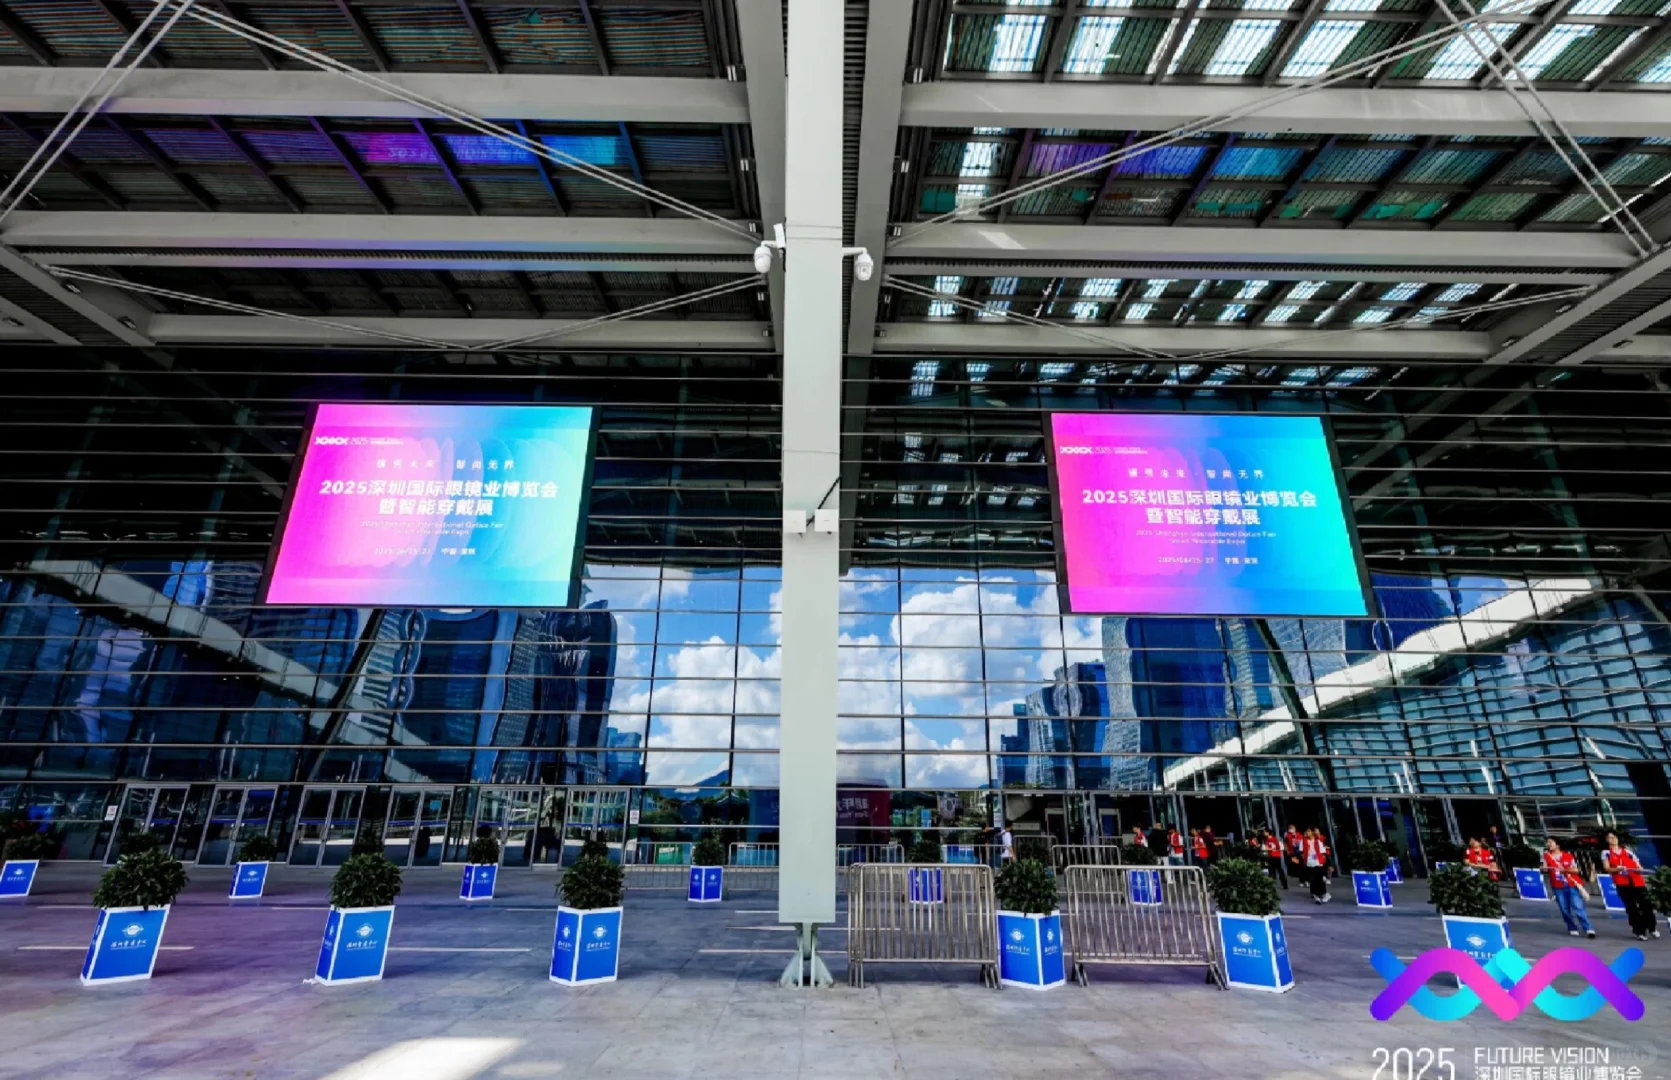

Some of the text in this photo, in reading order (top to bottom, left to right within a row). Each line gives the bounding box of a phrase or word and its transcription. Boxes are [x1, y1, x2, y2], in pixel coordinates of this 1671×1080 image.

[319, 479, 559, 499] 2025深圳国际眼镜业博览会
[378, 499, 493, 516] 暨智能穿戴展
[1082, 489, 1317, 508] 2025深圳国际眼镜业博览会
[1146, 508, 1261, 525] 暨智能穿戴展
